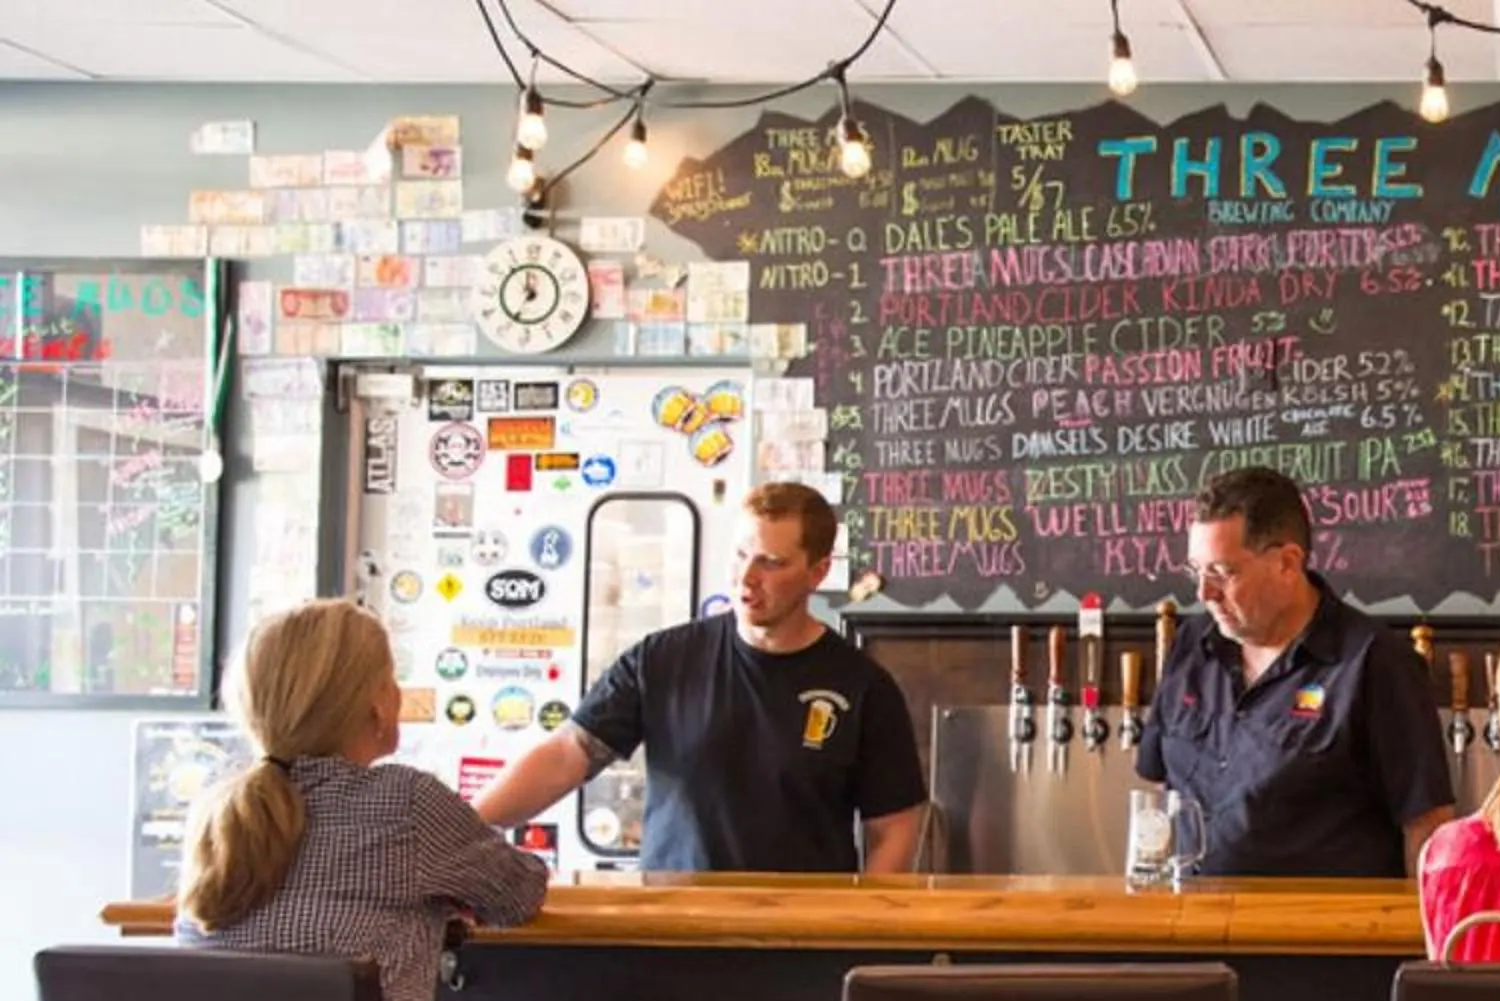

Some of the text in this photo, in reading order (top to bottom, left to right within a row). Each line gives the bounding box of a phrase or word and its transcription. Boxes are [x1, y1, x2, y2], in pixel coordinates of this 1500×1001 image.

[997, 120, 1073, 144] TASTER
[1096, 131, 1425, 200] THREE
[885, 214, 974, 255] DALE'S
[985, 209, 1043, 246] PALE
[1052, 206, 1099, 242] ALE
[1208, 200, 1397, 224] BREWING COMPANY
[989, 243, 1072, 287] MUGS
[879, 288, 1031, 328] PORTLAND
[1035, 283, 1142, 323] CIDER
[1162, 276, 1263, 314] KINDA
[1279, 268, 1339, 305] DRY
[876, 326, 933, 360] ACE
[946, 321, 1098, 361] PINEAPPLE
[1110, 313, 1226, 358] CIDER
[873, 357, 1006, 399] PORTLAND
[1006, 352, 1079, 388] CIDER
[1083, 345, 1202, 387] PASSION
[873, 397, 937, 435] THREE
[938, 391, 1016, 430] MUGS
[1031, 387, 1135, 422] PEACH
[874, 440, 936, 468] THREE
[944, 434, 1002, 465] MUGS
[1117, 420, 1200, 453] DESIRE
[1208, 413, 1280, 447] WHITE
[862, 436, 1402, 505] THREE MUGS ZESTY LASS IPA
[867, 504, 945, 542] THREE
[948, 504, 1018, 542] MUGS
[868, 540, 949, 578] THREE
[948, 540, 1027, 577] MUGS
